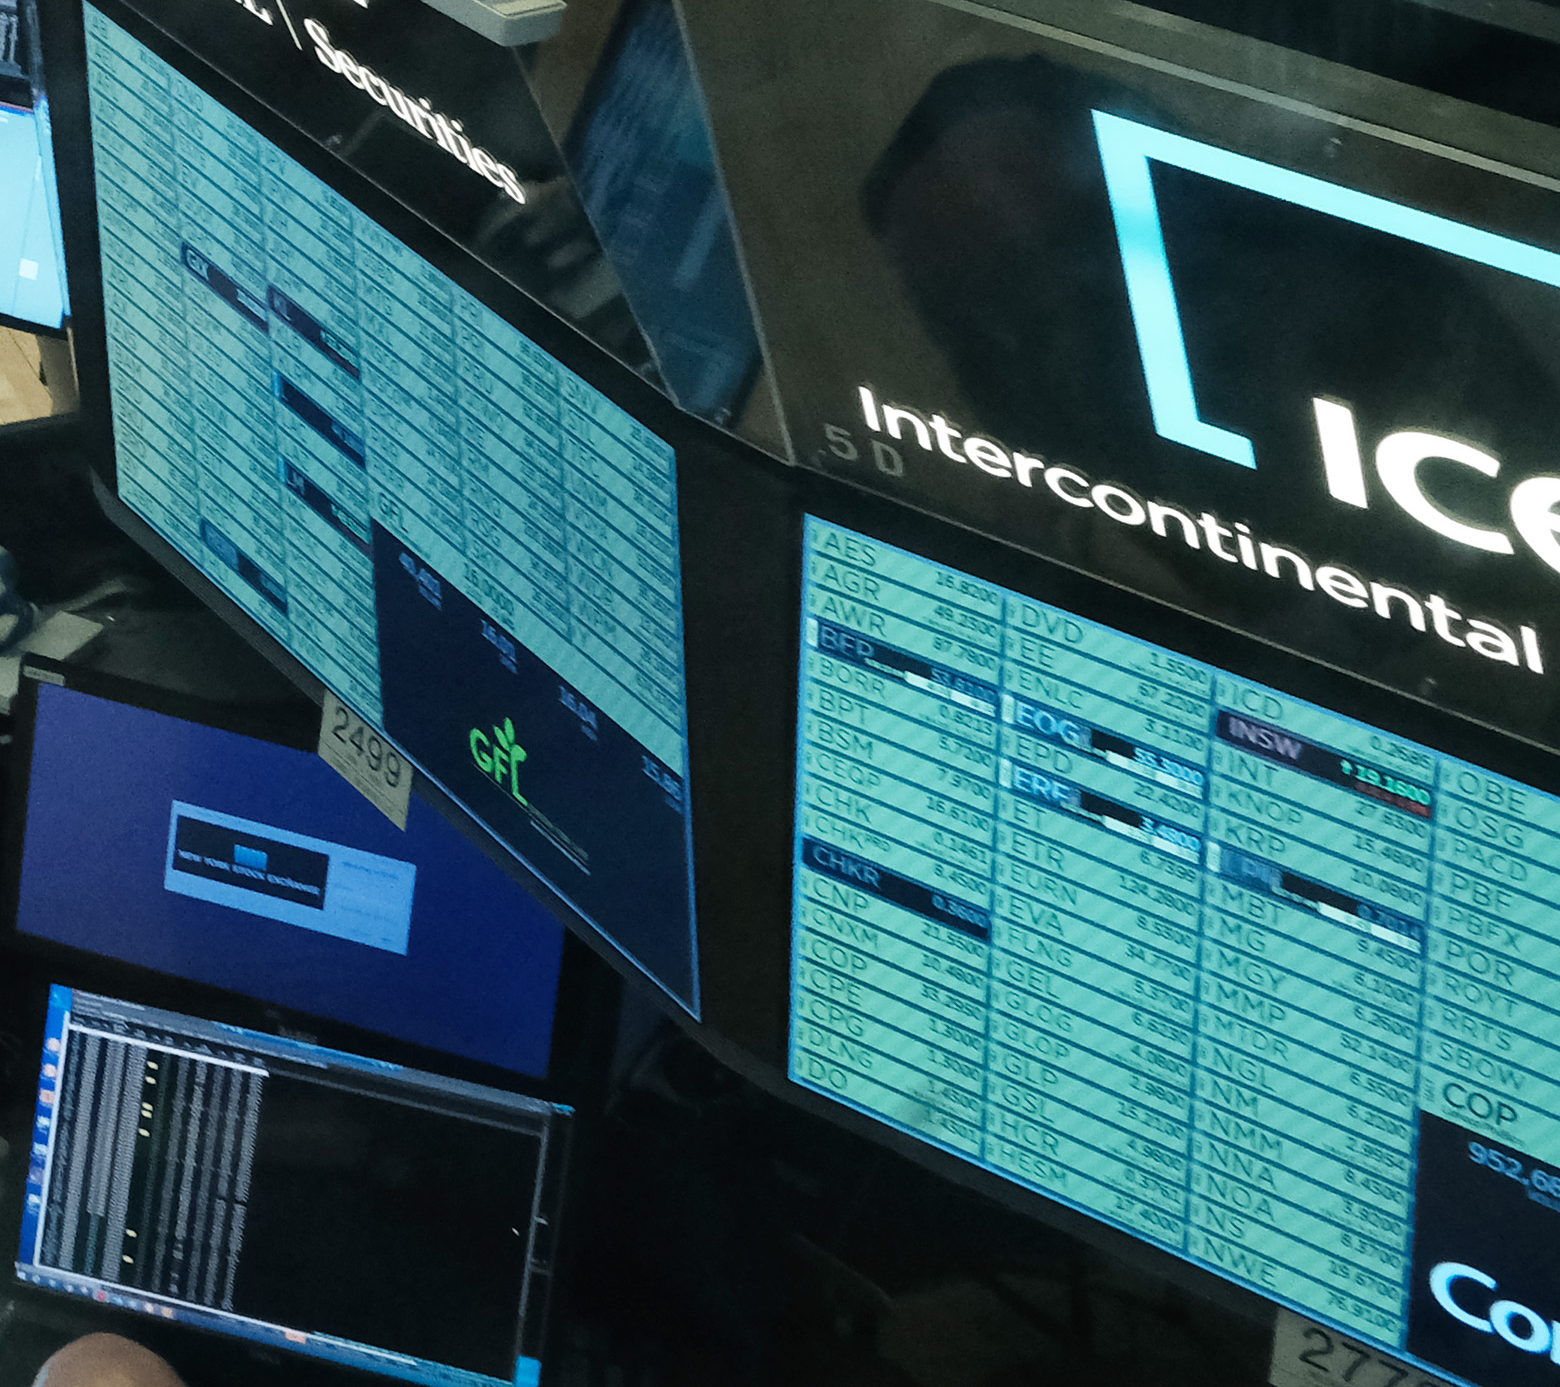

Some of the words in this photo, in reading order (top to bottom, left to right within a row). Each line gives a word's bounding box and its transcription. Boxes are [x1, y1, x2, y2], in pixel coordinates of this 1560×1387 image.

[303, 18, 527, 206] Securities
[824, 534, 877, 567] AES
[858, 386, 1545, 675] Intercontinental
[825, 565, 880, 601] AGR
[1024, 603, 1084, 644] DVD
[1232, 684, 1283, 720] ICD
[330, 705, 402, 786] 2499
[1229, 718, 1302, 759] INSW
[469, 717, 529, 807] GFL
[1455, 838, 1529, 883] PACD
[1443, 1082, 1517, 1126] COP
